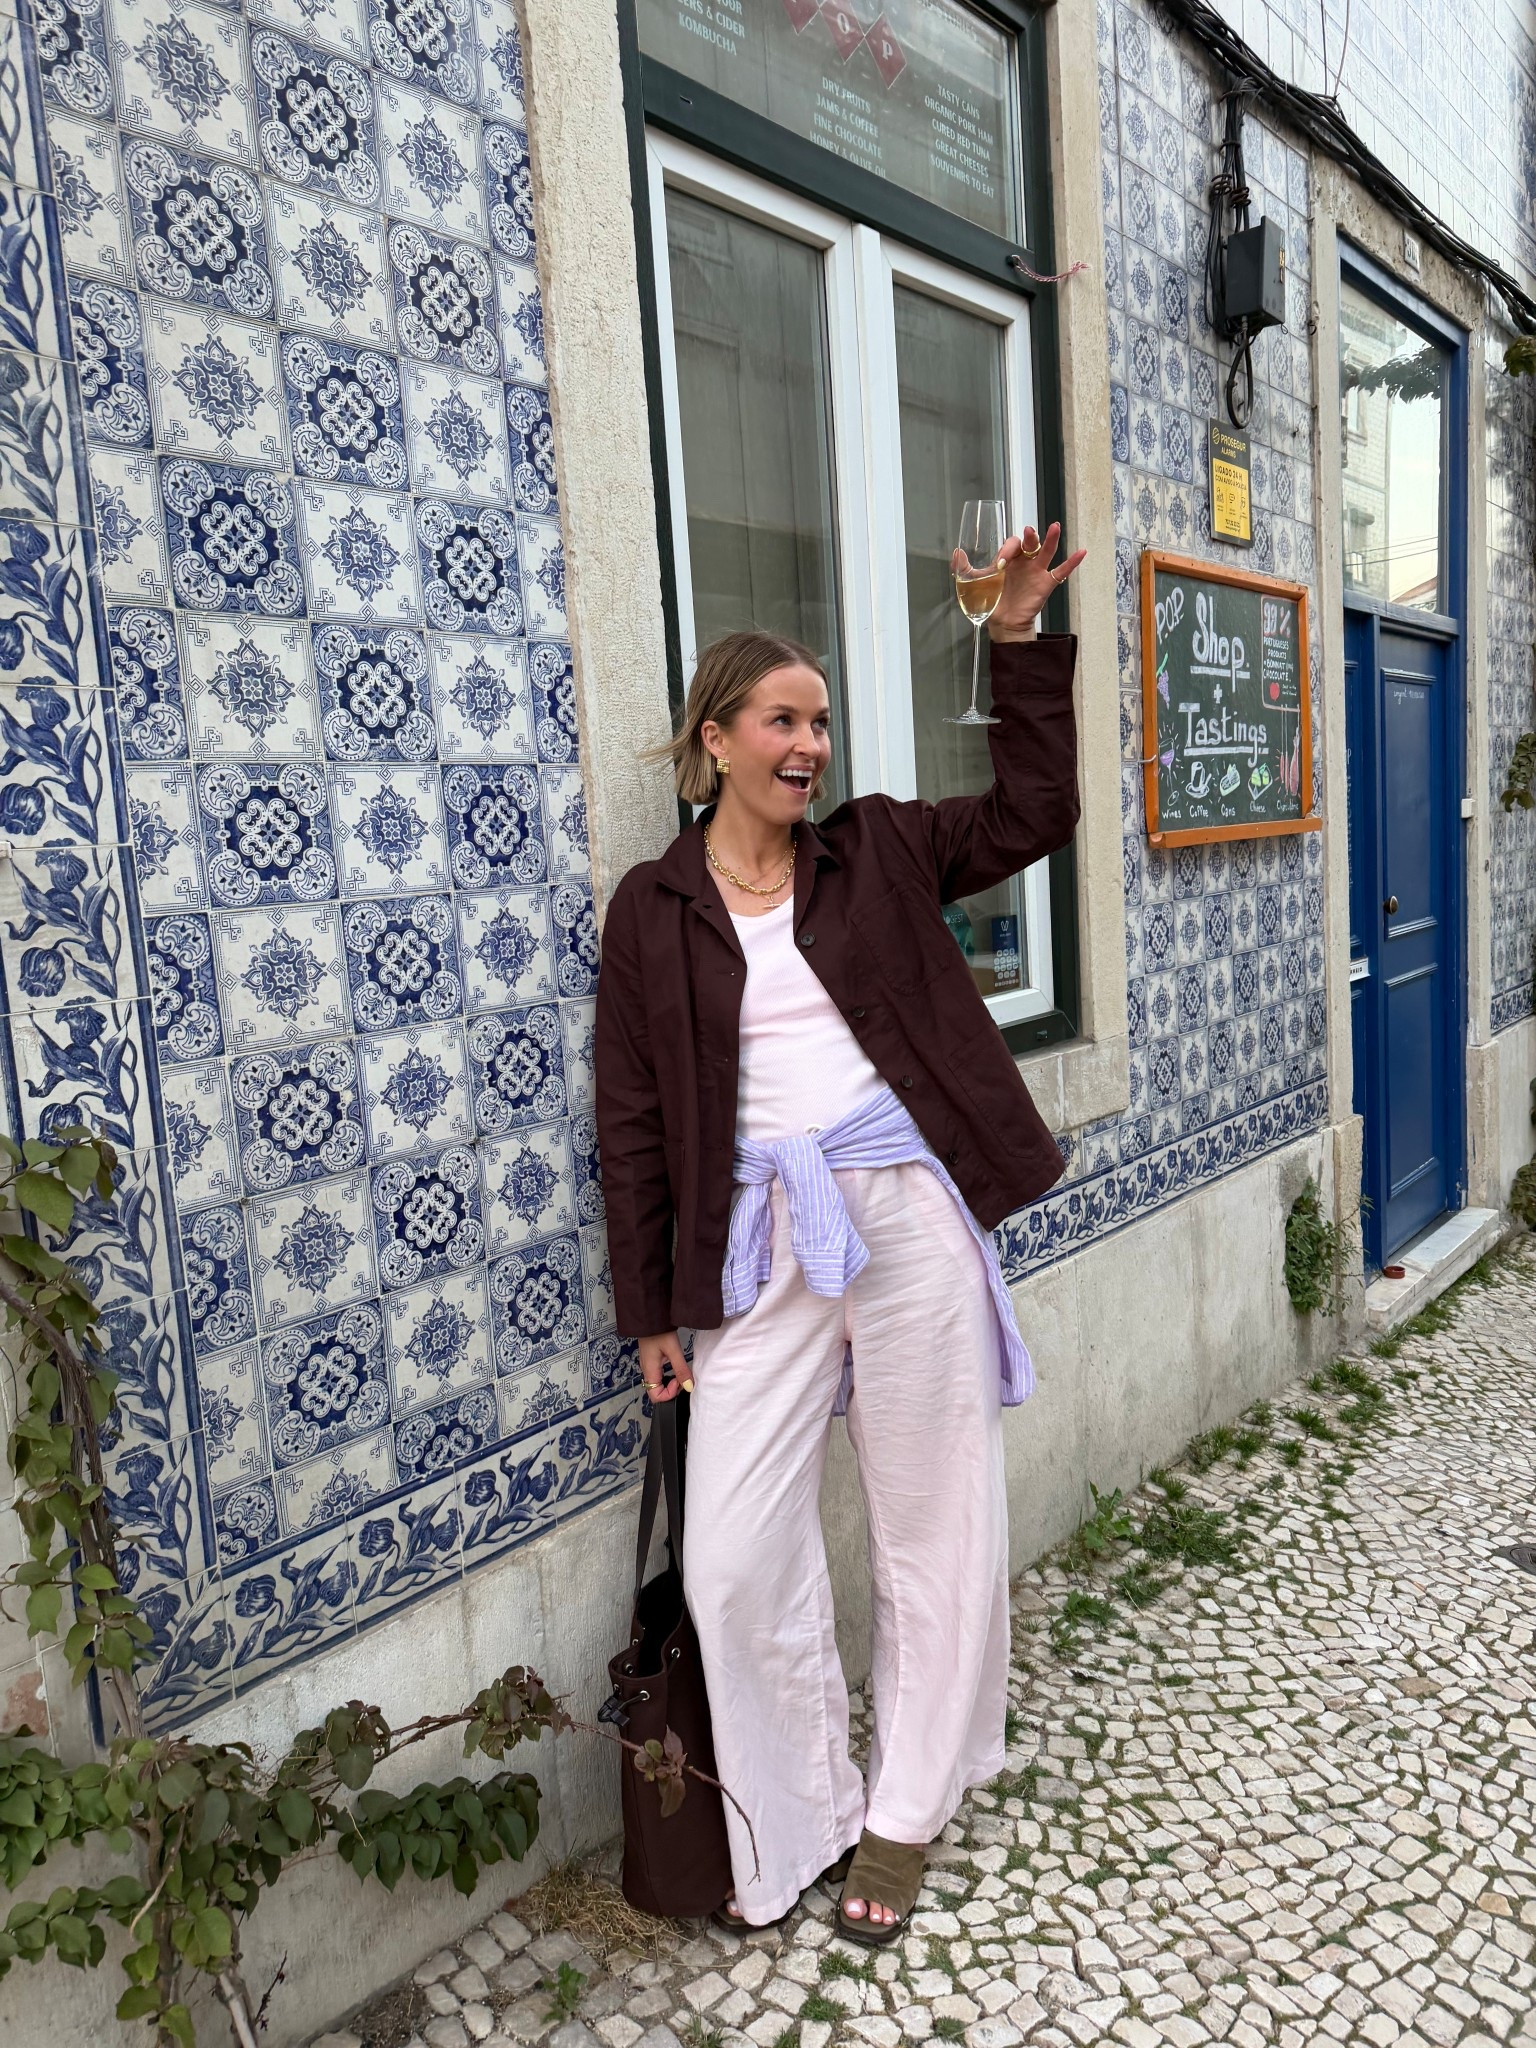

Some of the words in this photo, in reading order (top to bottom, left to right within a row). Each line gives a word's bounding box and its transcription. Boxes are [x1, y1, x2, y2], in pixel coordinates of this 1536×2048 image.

[679, 12, 737, 56] KOMBUCHA
[716, 12, 745, 38] CIDER
[816, 92, 840, 116] JAMS
[849, 112, 879, 138] COFFEE
[822, 76, 839, 96] DRY
[841, 87, 871, 114] FRUITS
[937, 83, 960, 107] TASTY
[961, 101, 980, 120] CANS
[813, 112, 833, 133] FINE
[834, 125, 883, 159] CHOCOLATE
[924, 95, 957, 123] ORGANIC
[958, 115, 976, 135] PORK
[978, 128, 994, 146] HAM
[932, 118, 956, 140] CURED
[957, 133, 971, 150] RED
[972, 142, 991, 161] TUNA
[930, 154, 971, 185] SOUVENIRS
[971, 177, 981, 191] TO
[982, 183, 995, 199] EAT
[935, 138, 958, 160] GREAT
[959, 153, 989, 178] CHEESES
[1220, 433, 1247, 453] PROSEGUR
[1178, 703, 1268, 768] Tastings
[1189, 805, 1209, 818] Coffee
[1220, 804, 1236, 818] Cans
